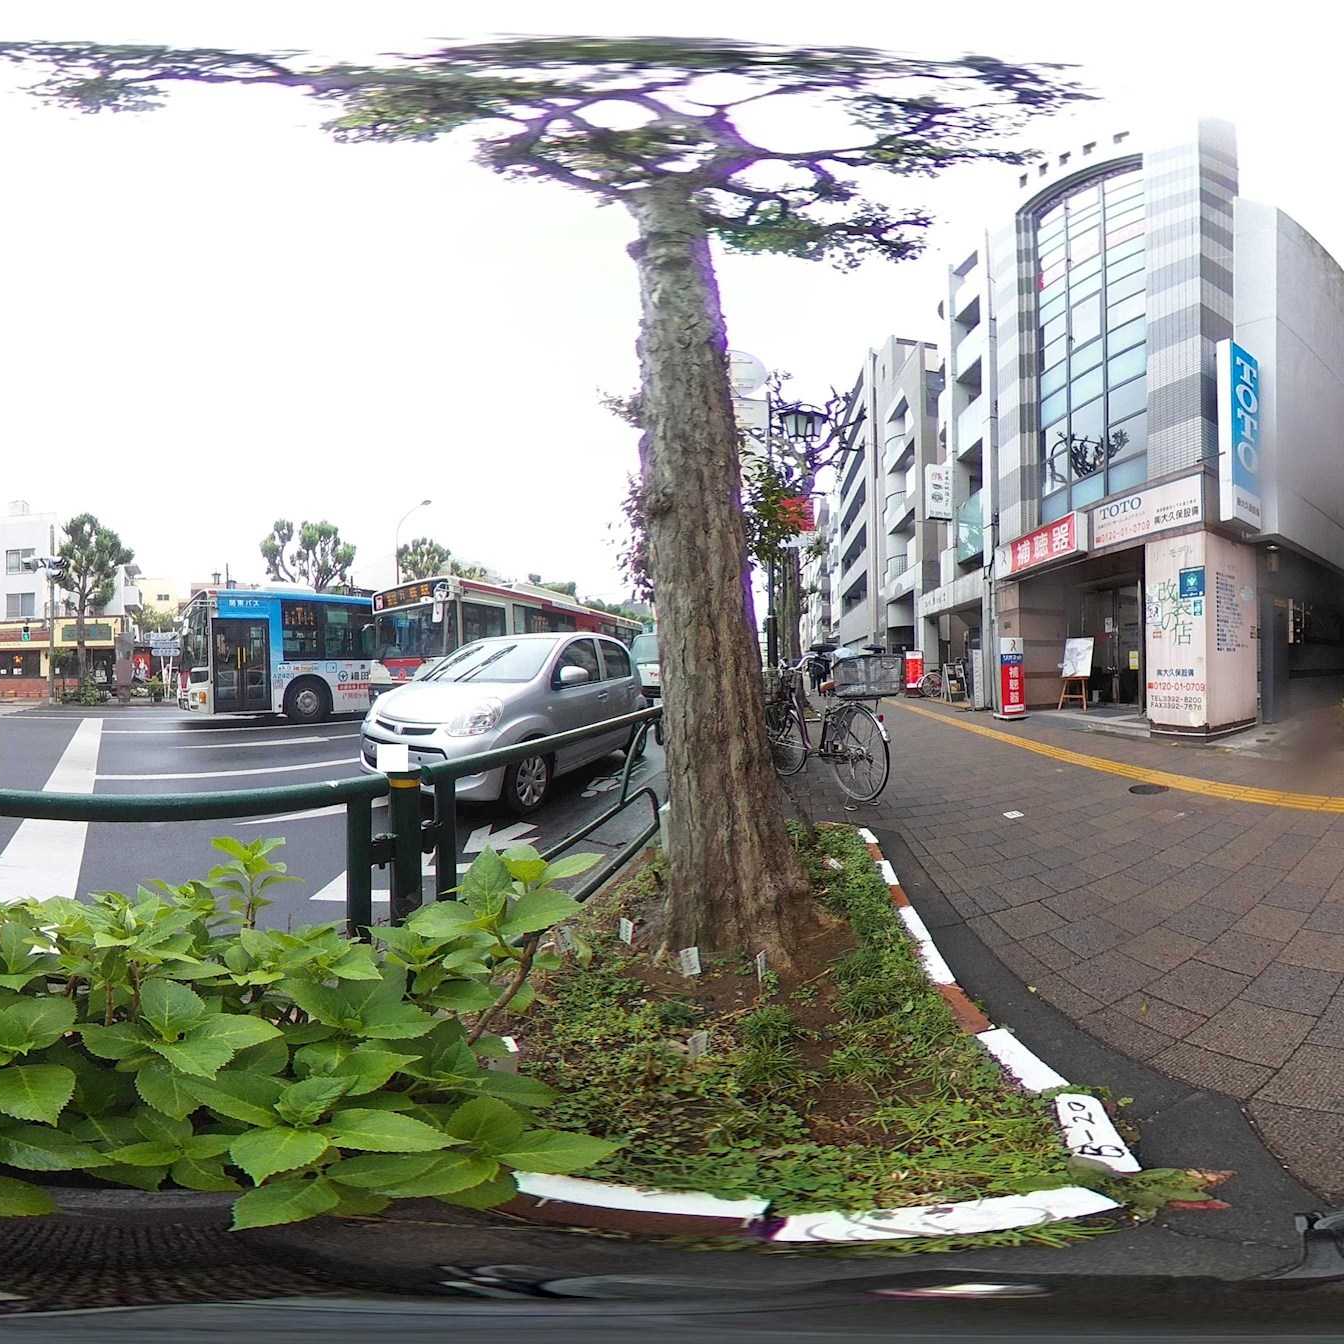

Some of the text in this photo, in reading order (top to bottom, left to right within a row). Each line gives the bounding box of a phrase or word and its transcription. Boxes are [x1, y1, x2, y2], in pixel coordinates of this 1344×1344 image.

[1235, 355, 1258, 475] TOTO
[1099, 496, 1142, 520] TOTO
[1017, 523, 1069, 567] 補聴器
